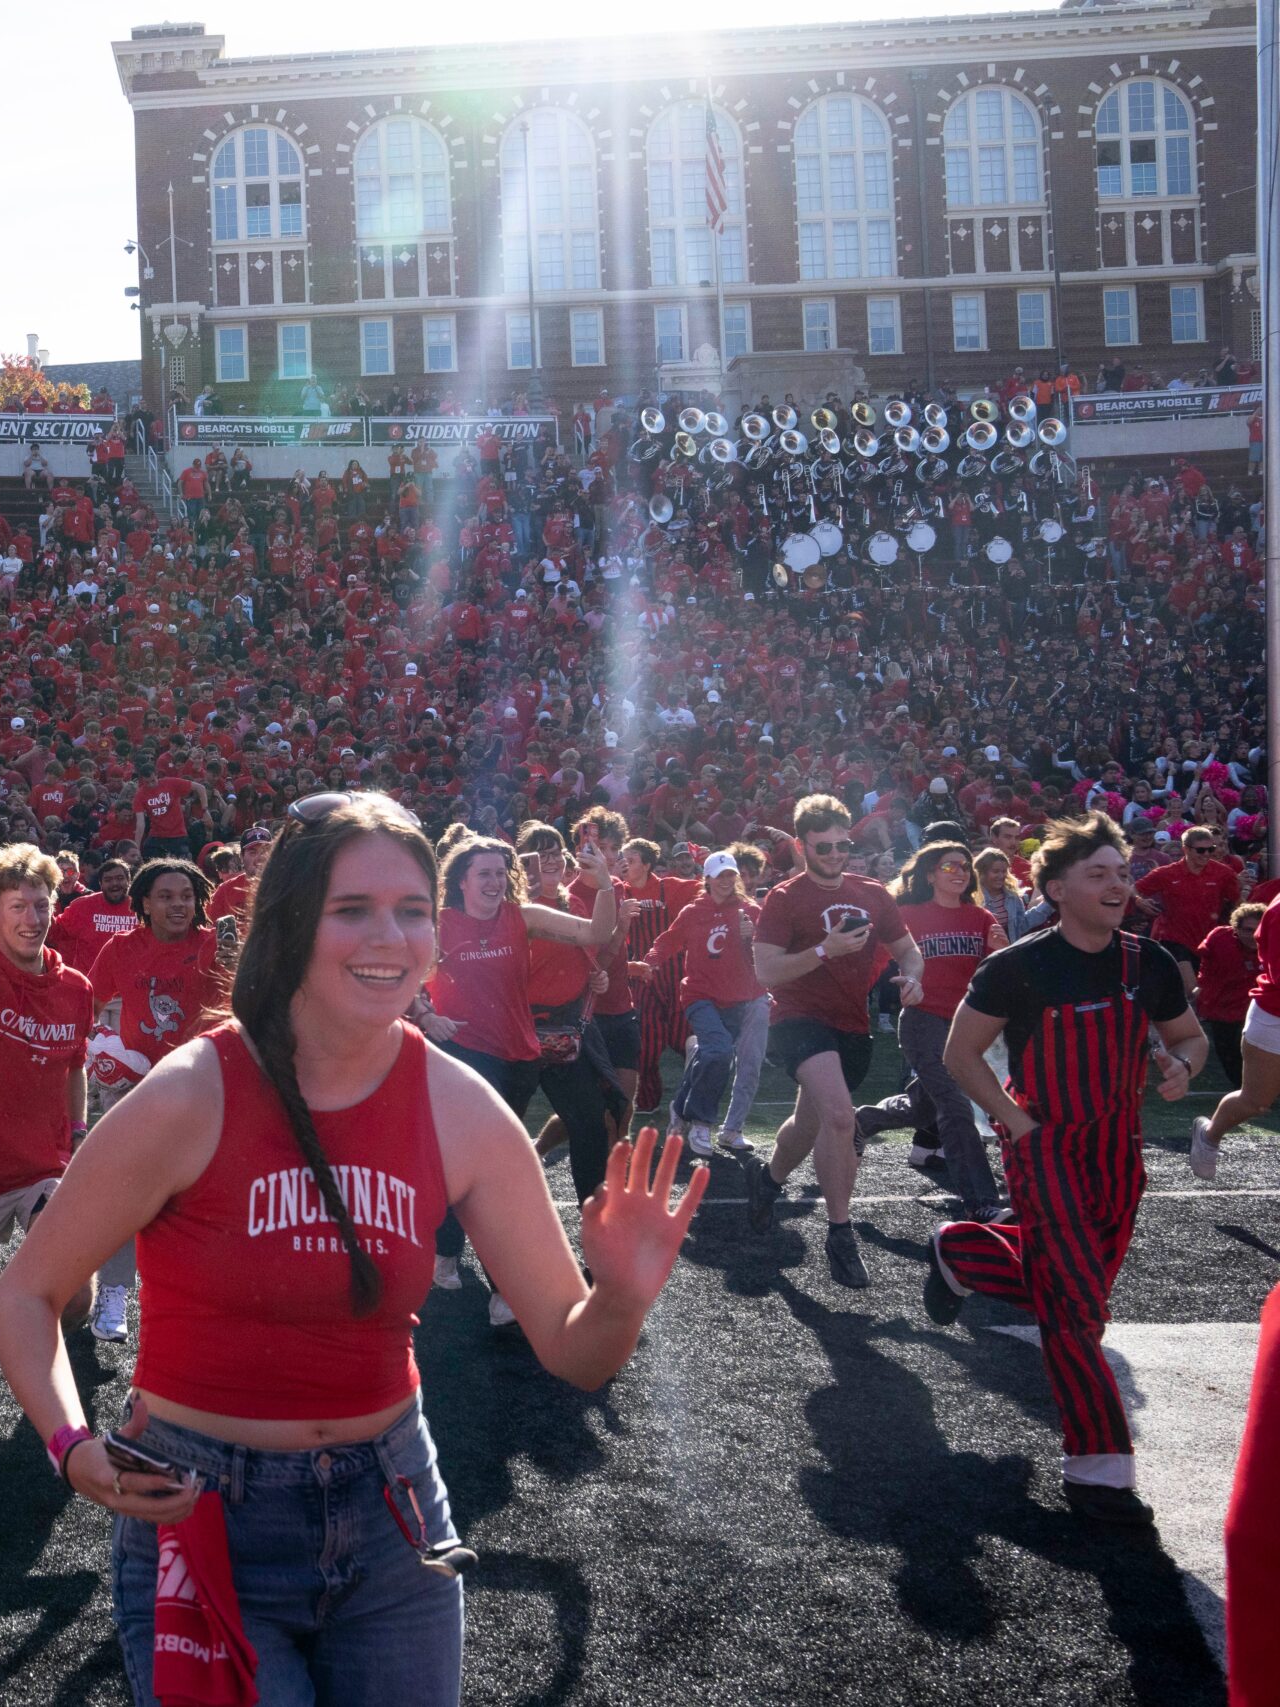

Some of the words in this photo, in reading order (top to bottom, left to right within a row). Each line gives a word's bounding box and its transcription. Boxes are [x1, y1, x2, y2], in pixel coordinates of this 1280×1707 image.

[1095, 400, 1155, 412] BEARCATS
[1157, 397, 1204, 408] MOBILE
[32, 421, 99, 437] SECTION
[197, 424, 253, 433] BEARCATS
[254, 425, 296, 434] MOBILE
[405, 424, 473, 440] STUDENT
[475, 423, 540, 439] SCTION
[147, 791, 171, 807] CINCY
[151, 805, 168, 816] 513
[459, 945, 514, 961] CINCINNATI
[0, 1008, 76, 1041] CINCINNATI
[247, 1164, 423, 1249] CINCINNATI
[292, 1235, 385, 1255] BEARCTS
